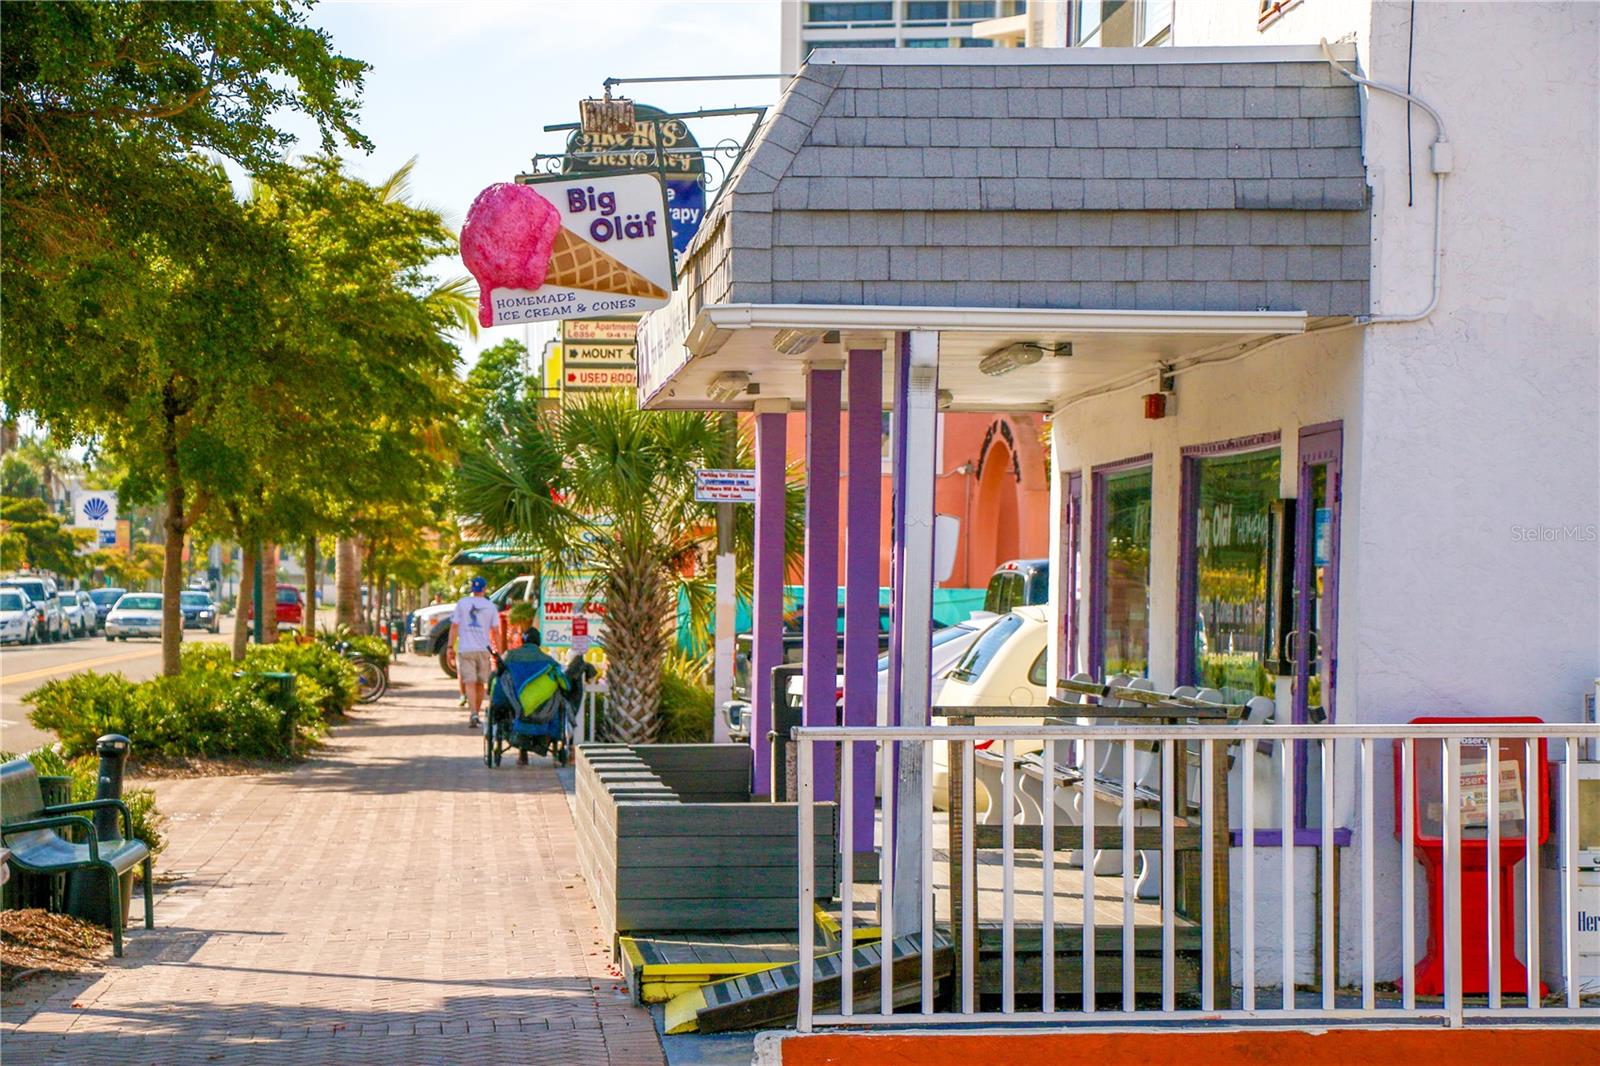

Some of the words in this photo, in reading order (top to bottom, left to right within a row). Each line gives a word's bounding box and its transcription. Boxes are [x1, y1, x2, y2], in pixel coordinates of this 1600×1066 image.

[566, 186, 617, 216] Big
[590, 211, 657, 243] Oläf
[496, 292, 576, 309] HOMEMADE
[498, 310, 521, 321] ICE
[524, 304, 572, 319] CREAM
[576, 303, 587, 313] &
[592, 299, 637, 312] CONES
[573, 321, 589, 331] For
[567, 329, 596, 338] Lease
[581, 348, 623, 358] MOUNT
[580, 373, 608, 383] USED
[544, 602, 573, 613] TAROT
